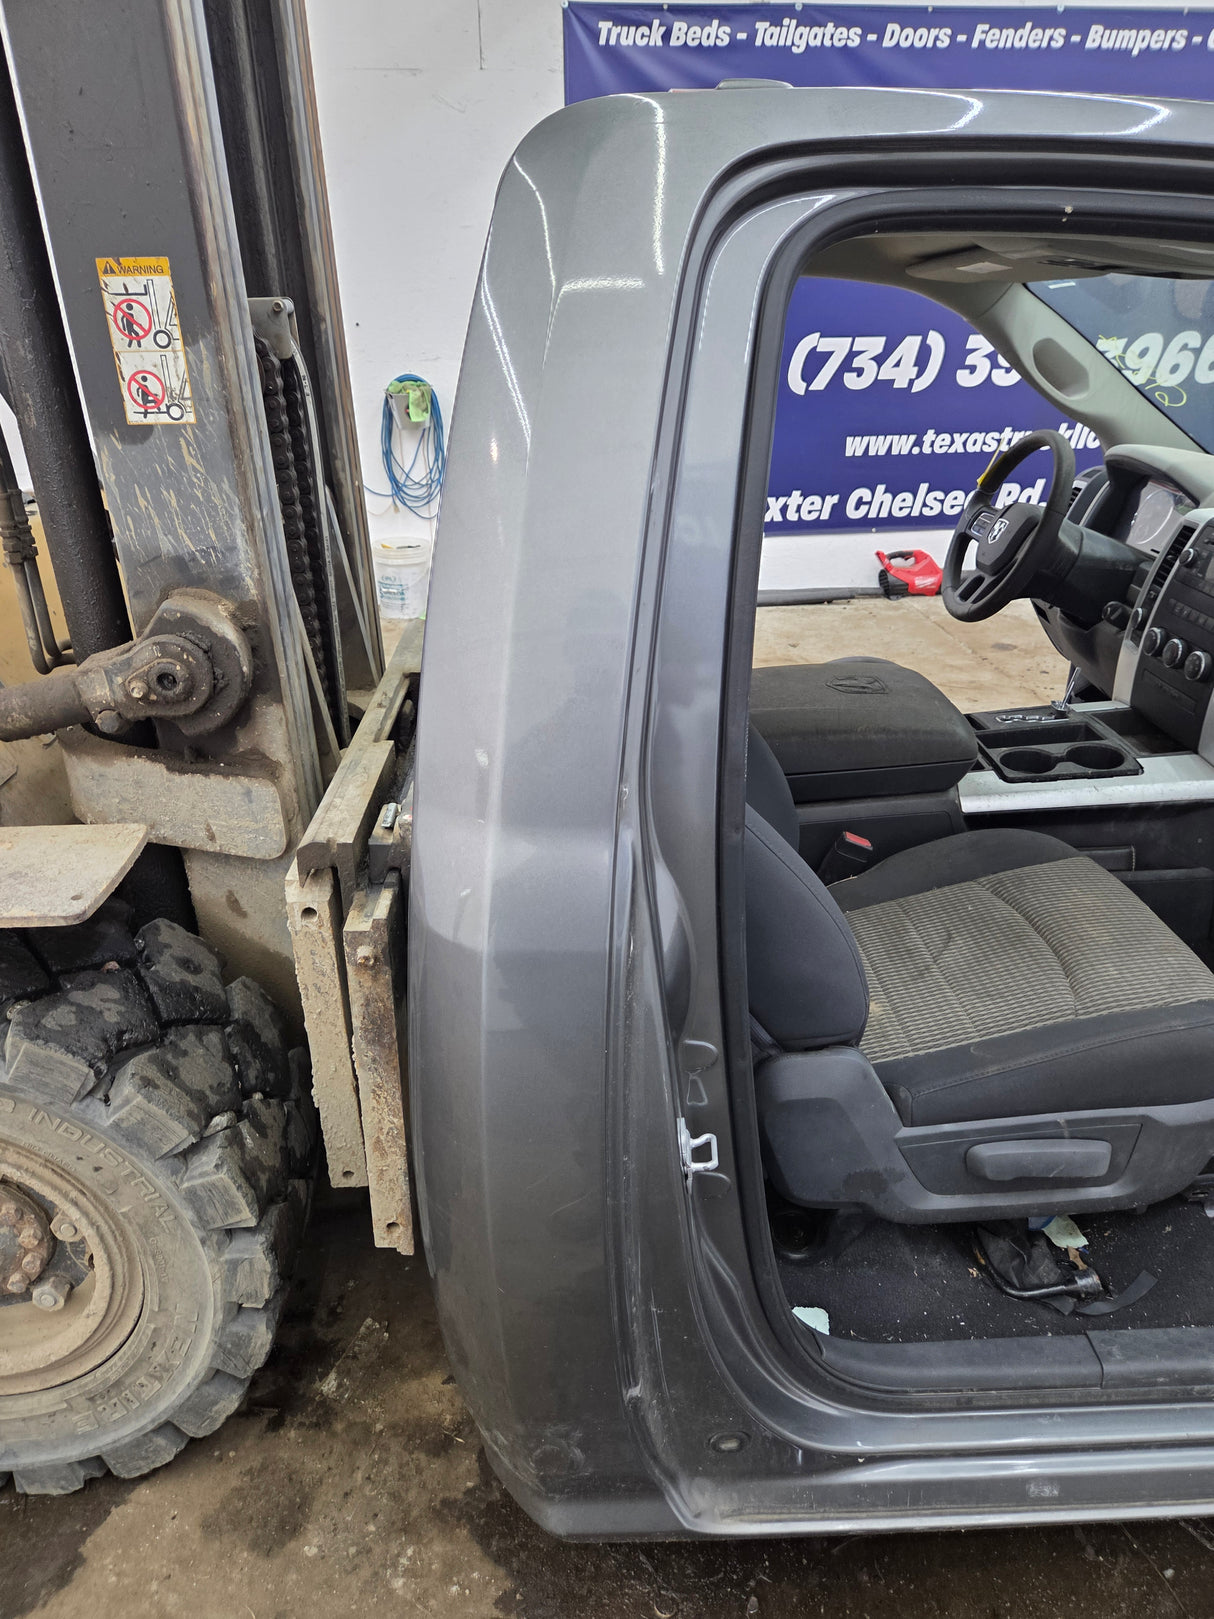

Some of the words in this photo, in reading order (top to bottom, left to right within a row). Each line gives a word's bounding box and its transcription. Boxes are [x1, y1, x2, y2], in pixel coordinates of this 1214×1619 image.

[599, 19, 666, 47] Truck
[670, 20, 731, 47] Beds
[755, 18, 861, 53] Tailgates
[882, 23, 952, 49] Doors
[971, 22, 1067, 49] Fenders
[1085, 24, 1189, 57] Bumpers
[117, 264, 164, 275] WARNING
[787, 330, 945, 395] (734)
[845, 422, 1101, 457] www.texastrkllc
[28, 1107, 178, 1233] INDUSTRIAL
